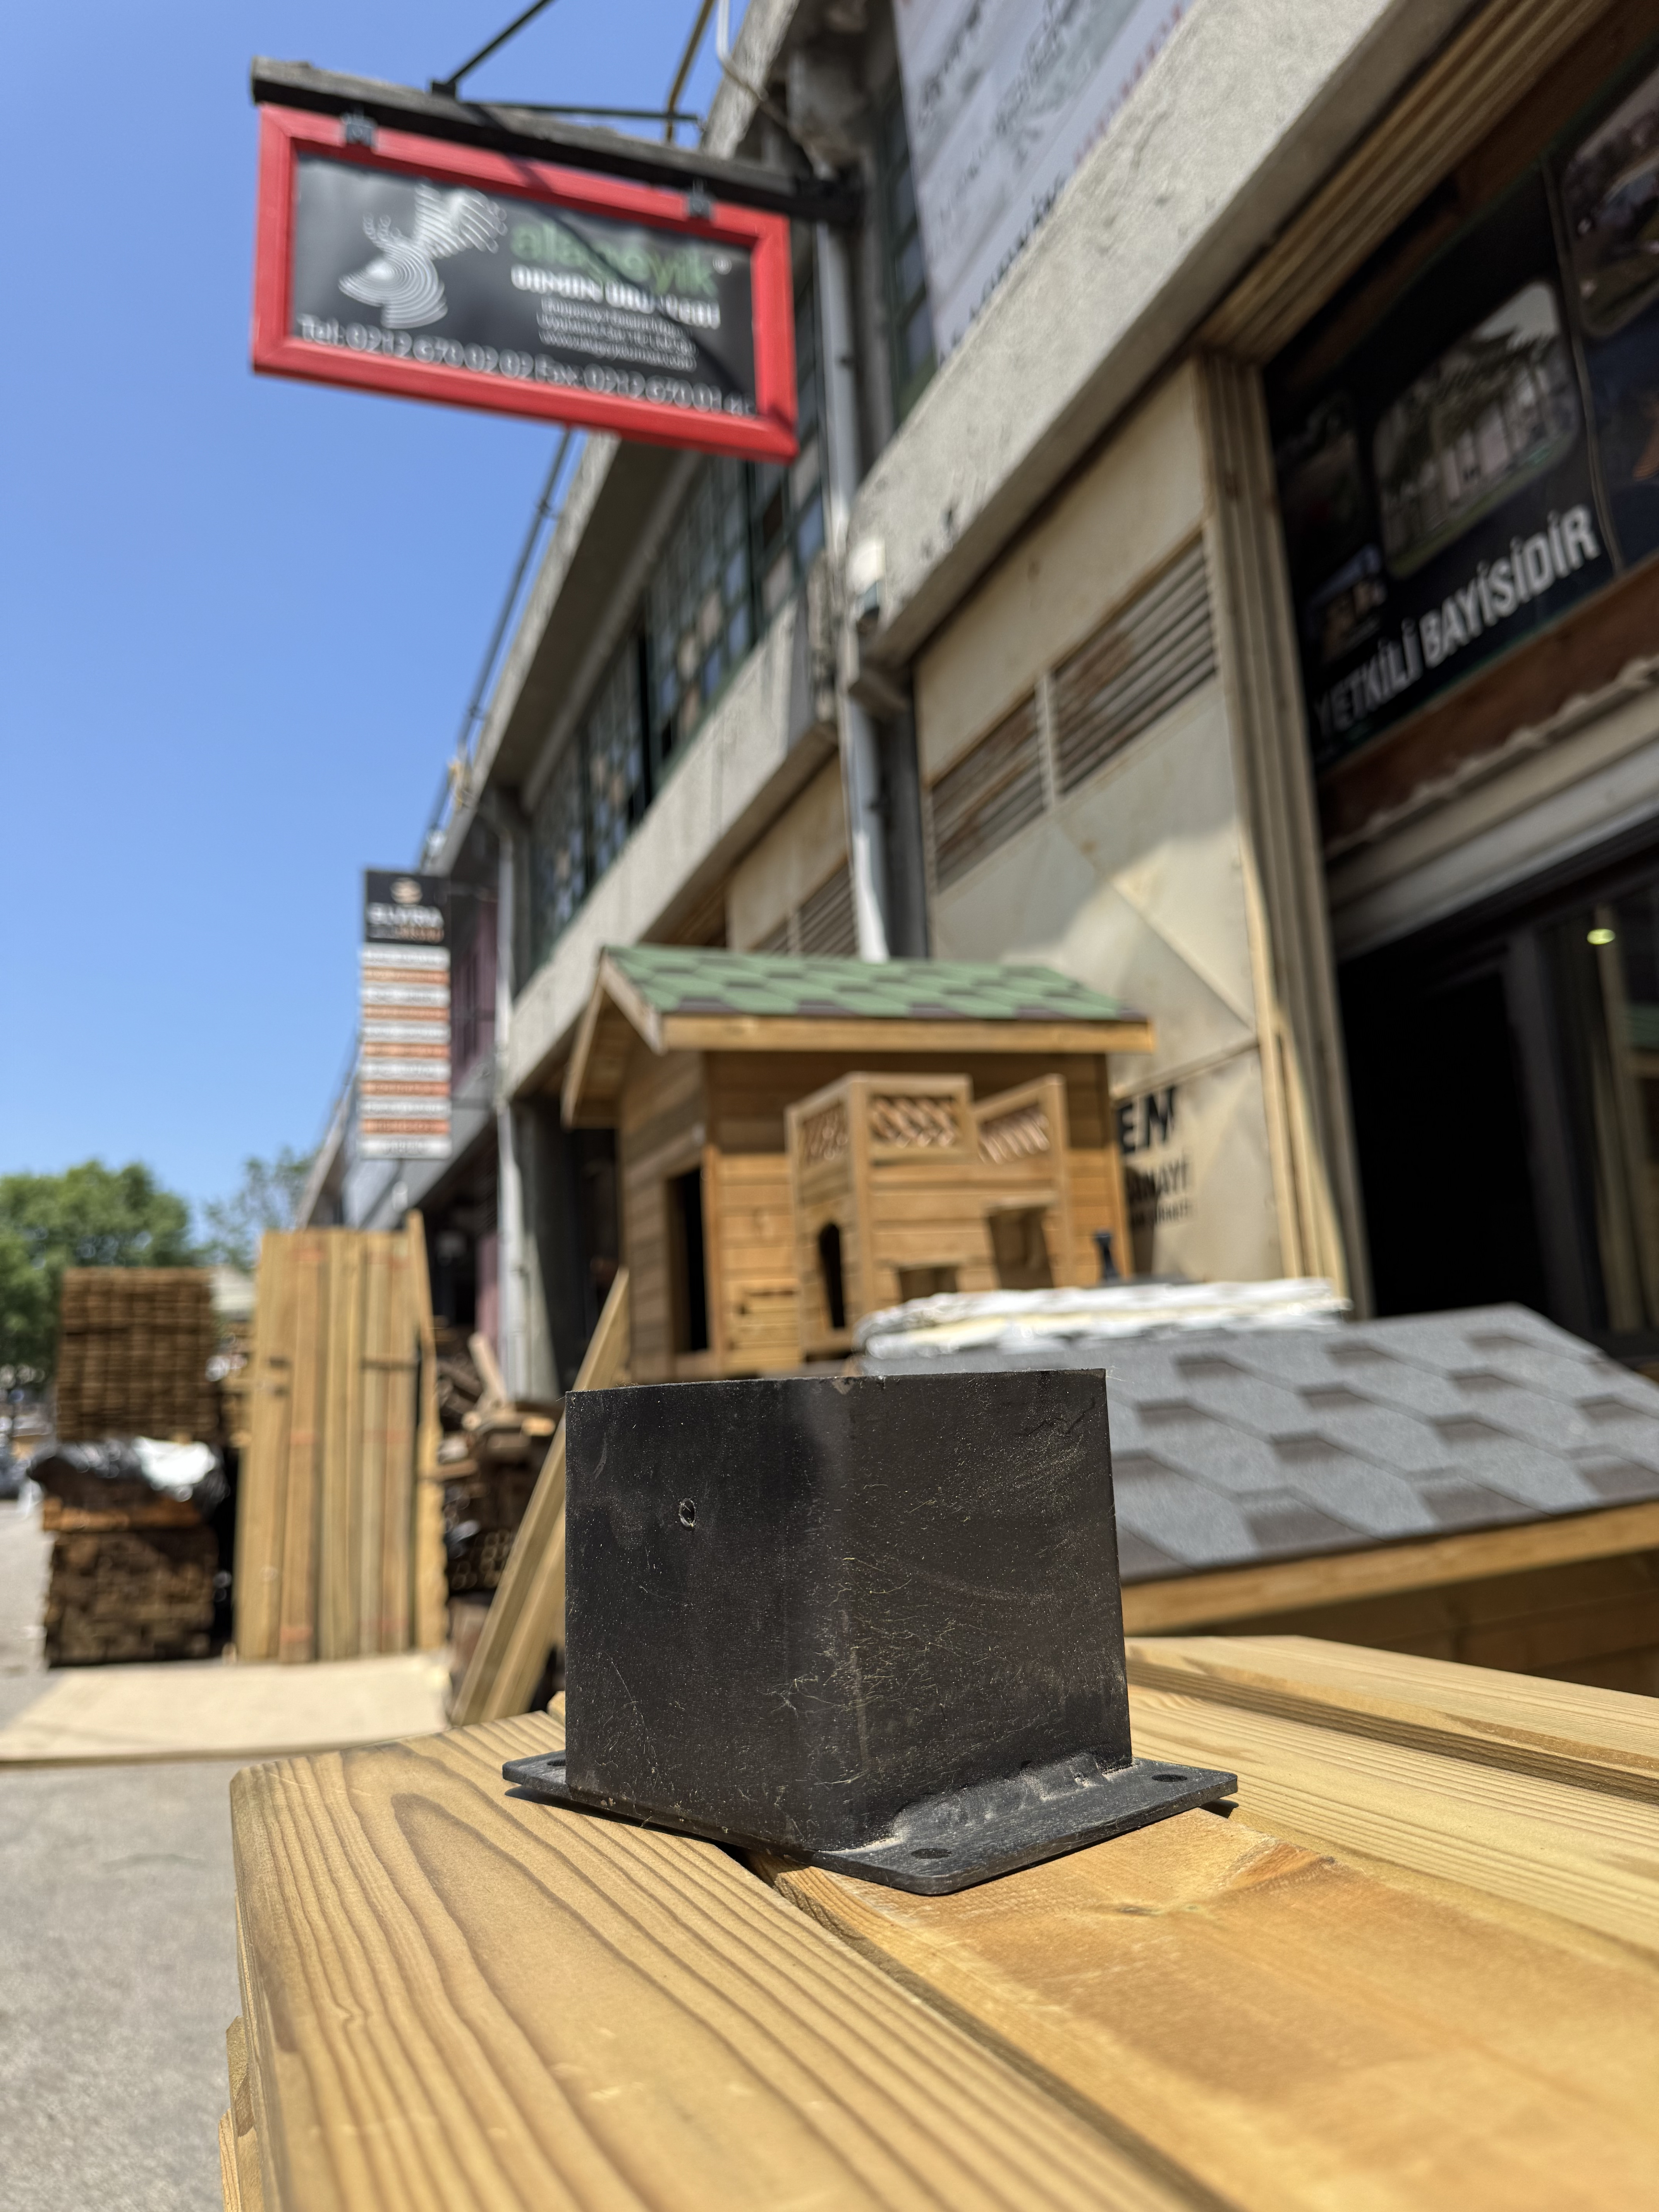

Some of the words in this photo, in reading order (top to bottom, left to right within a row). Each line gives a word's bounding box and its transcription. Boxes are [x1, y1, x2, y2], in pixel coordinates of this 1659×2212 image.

[346, 322, 413, 358] 0212
[464, 342, 499, 373] 02
[498, 349, 534, 380] 02
[583, 363, 646, 398] 0212
[1313, 617, 1425, 739] YETKİLİ
[1419, 504, 1601, 669] BAYİSİDİR
